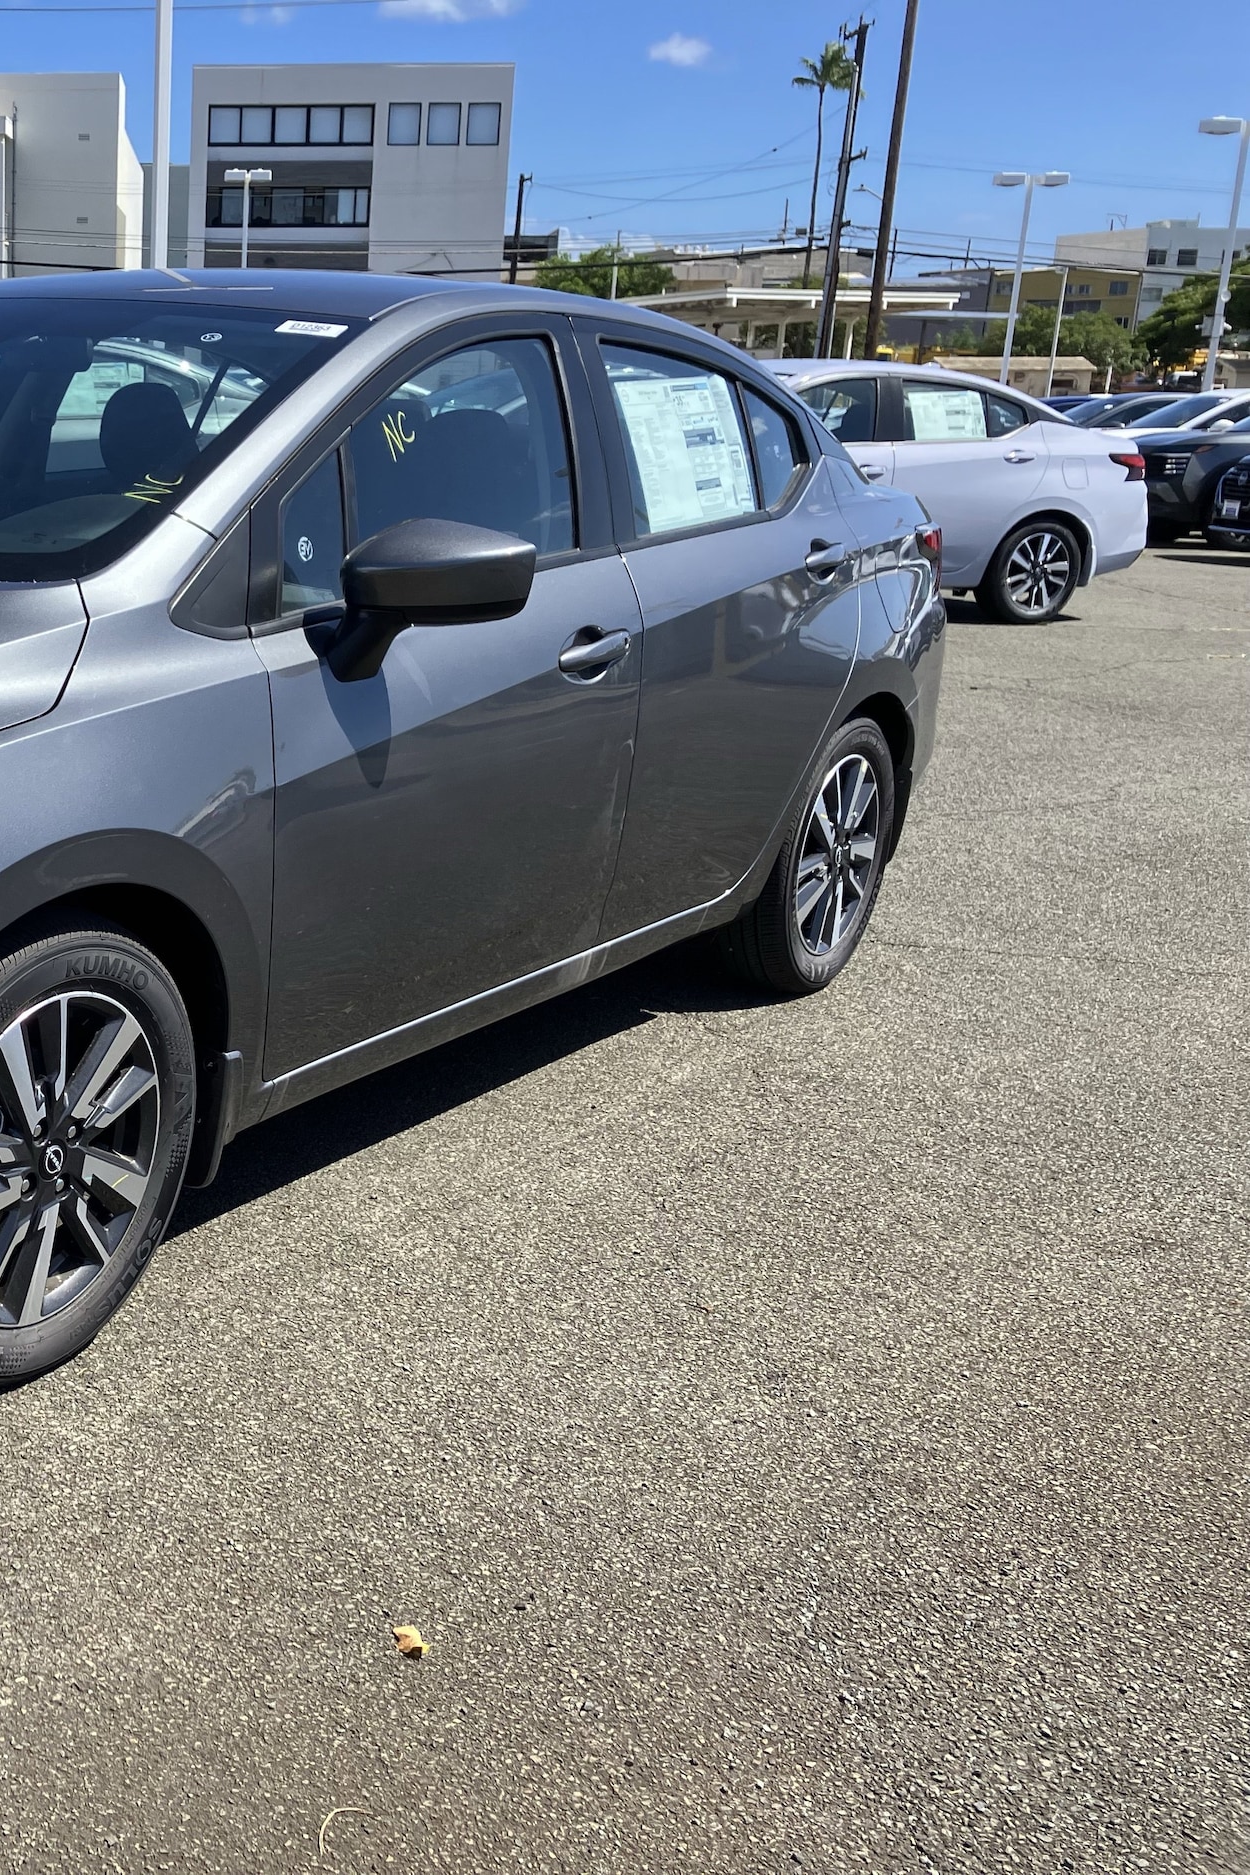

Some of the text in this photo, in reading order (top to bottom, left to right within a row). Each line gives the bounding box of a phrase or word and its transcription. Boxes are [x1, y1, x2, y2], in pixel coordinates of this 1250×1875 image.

[381, 411, 418, 463] NC
[121, 473, 184, 504] NC
[65, 955, 150, 991] KUMHO
[94, 1217, 163, 1322] SOLUS
